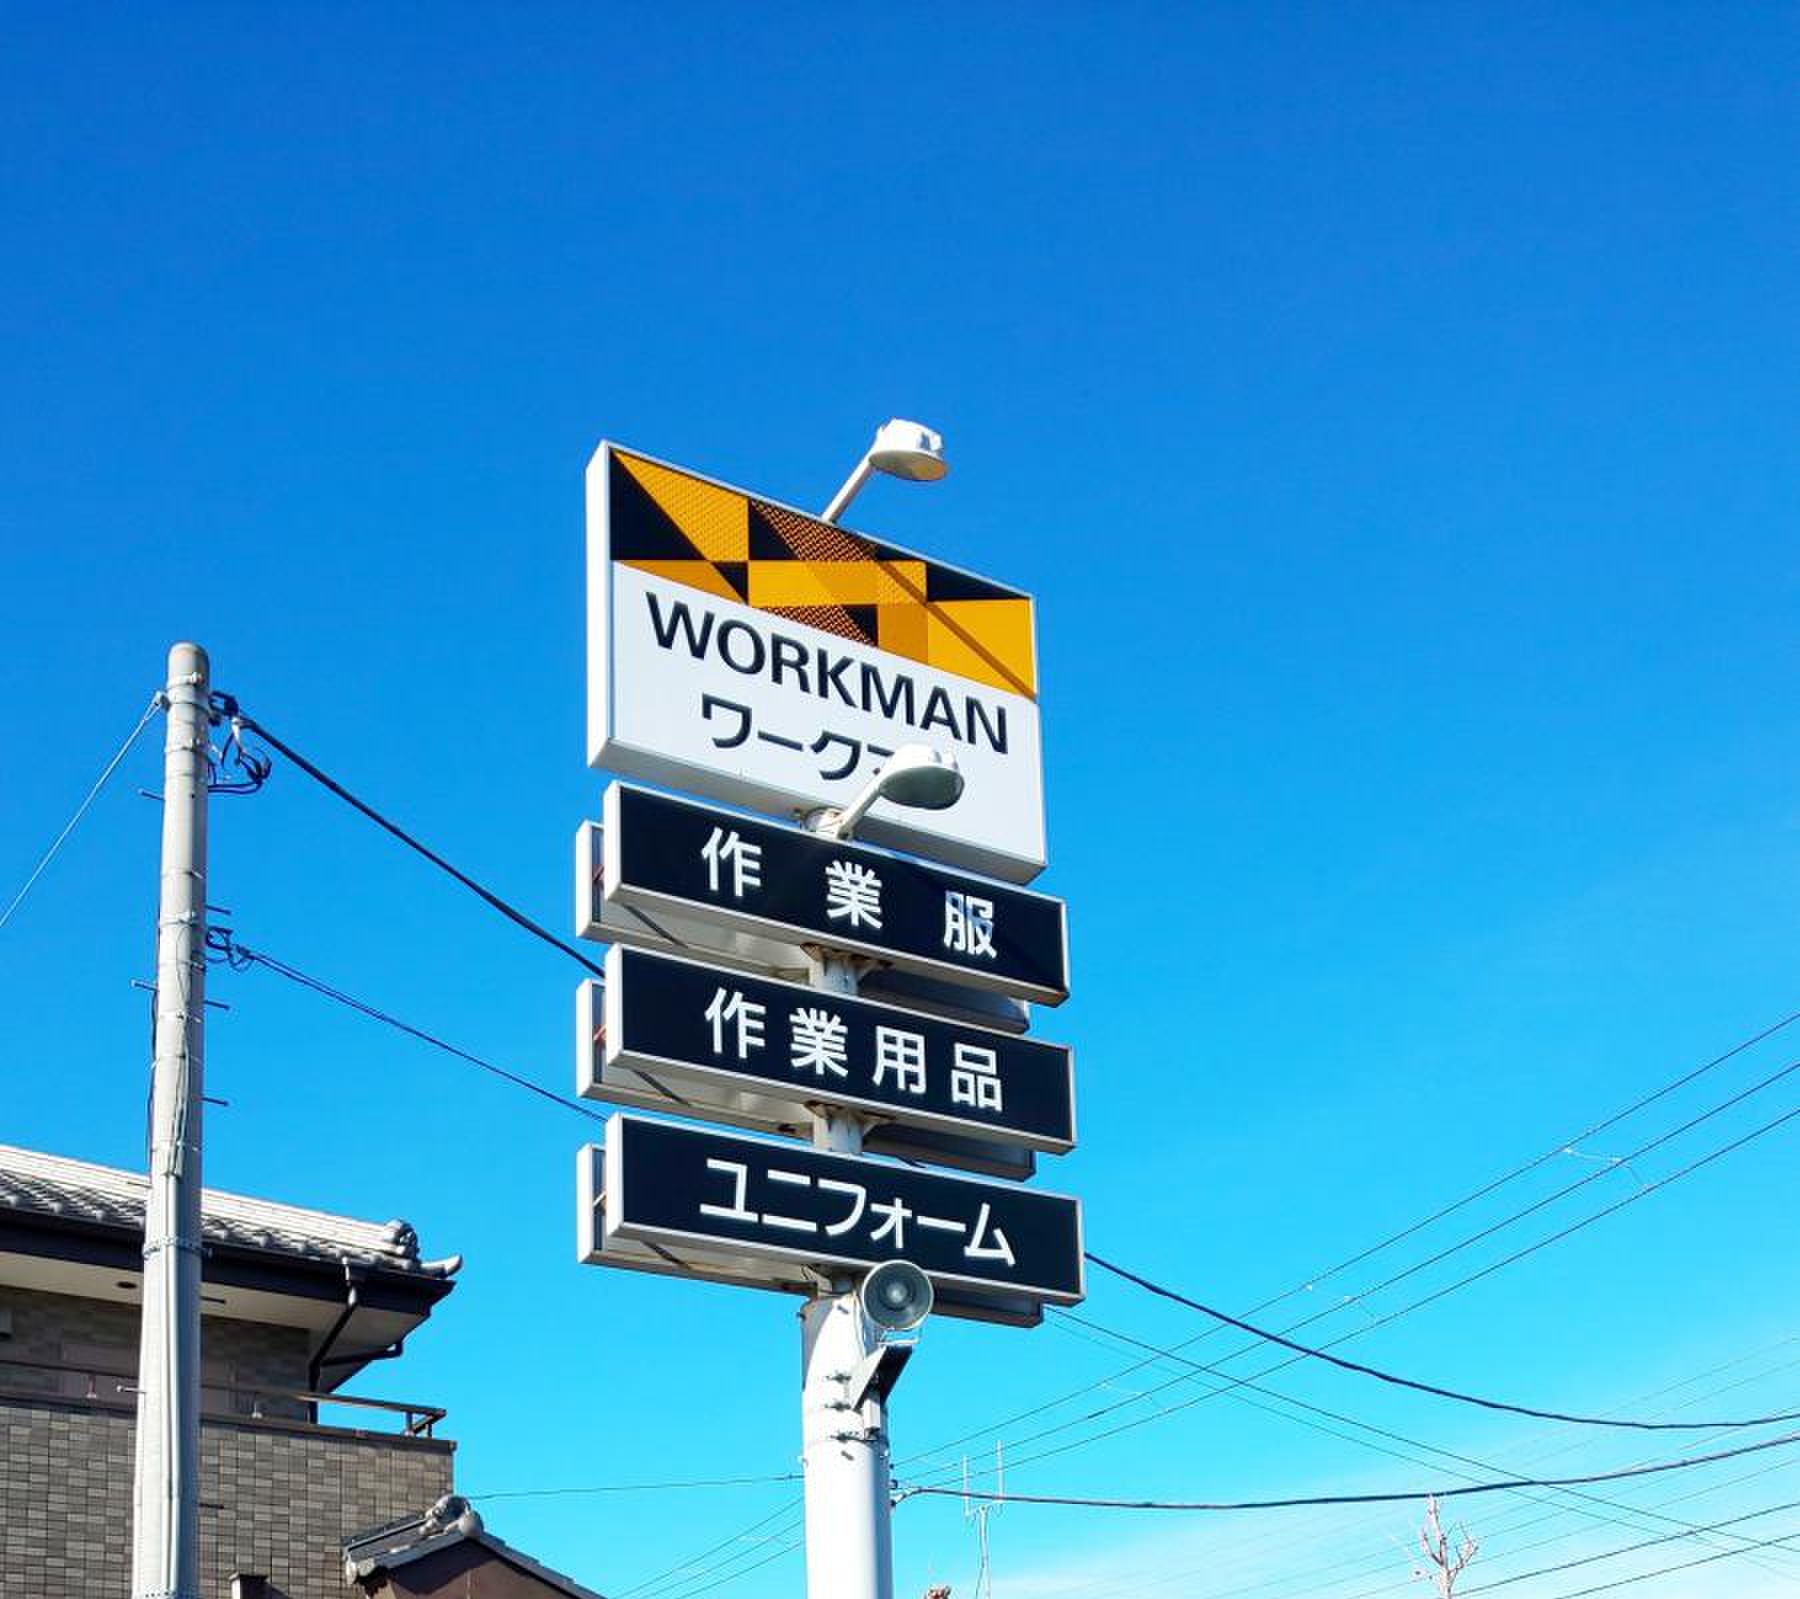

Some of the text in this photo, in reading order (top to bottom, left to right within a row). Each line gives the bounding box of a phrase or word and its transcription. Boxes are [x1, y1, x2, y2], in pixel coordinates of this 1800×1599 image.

[645, 590, 1009, 755] WORKMAN
[701, 692, 896, 782] ワーク
[701, 827, 997, 959] 作業服
[704, 987, 1003, 1112] 作業用品
[700, 1157, 1016, 1267] ユニフォーム
